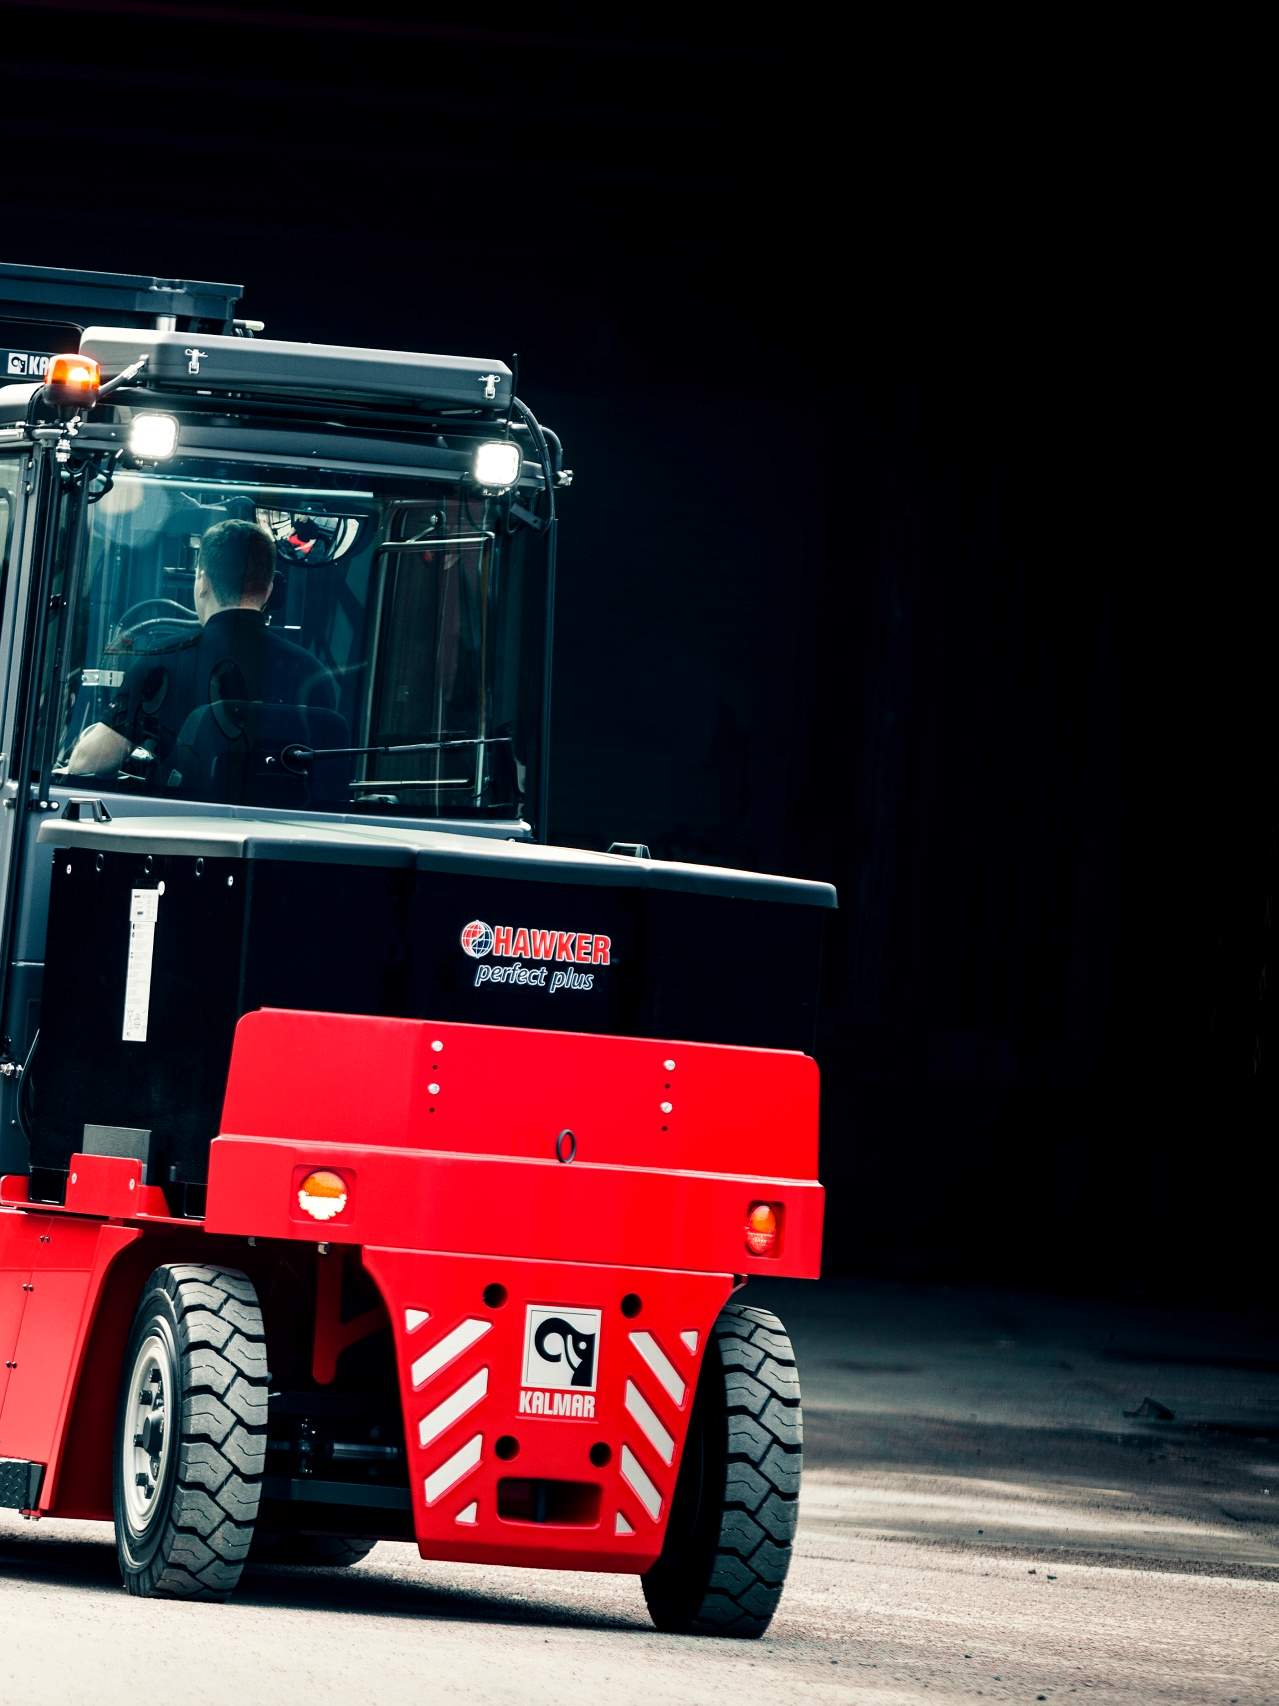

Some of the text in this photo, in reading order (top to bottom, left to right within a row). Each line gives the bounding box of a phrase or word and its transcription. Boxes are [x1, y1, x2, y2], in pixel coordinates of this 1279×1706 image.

[494, 926, 612, 965] HAWKER
[475, 962, 594, 993] perfect plus
[519, 1391, 596, 1418] KALMAR
